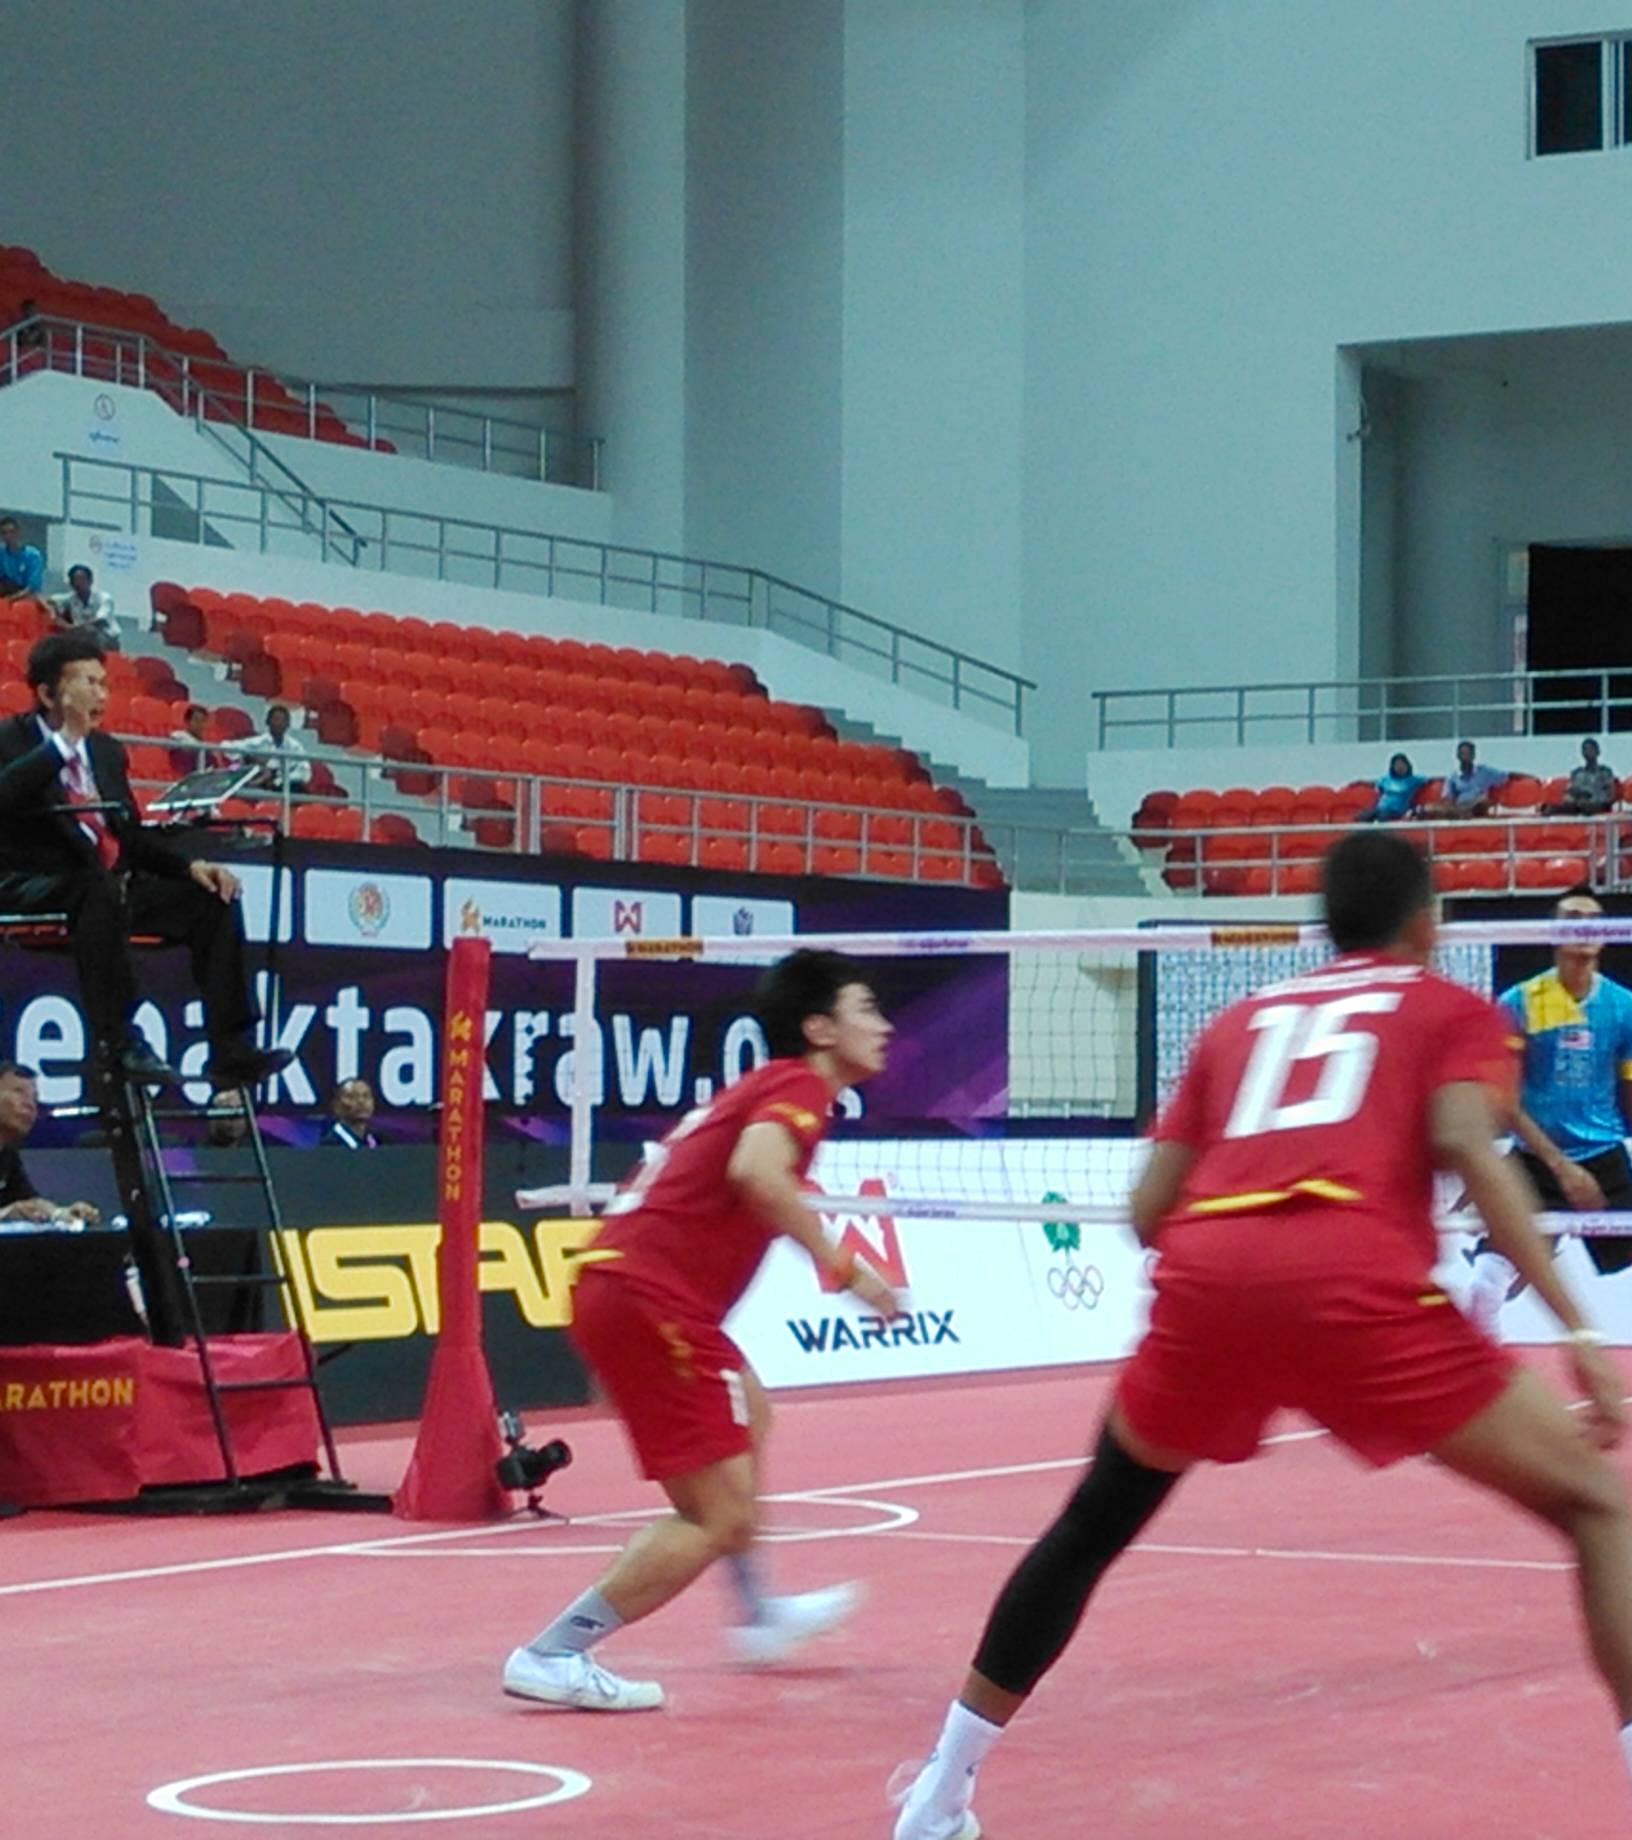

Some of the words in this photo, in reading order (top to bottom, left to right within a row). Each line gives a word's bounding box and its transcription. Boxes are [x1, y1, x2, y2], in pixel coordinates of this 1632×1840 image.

[482, 914, 548, 931] MARATHON
[1222, 991, 1405, 1140] 15
[444, 1049, 469, 1201] MARATHON
[786, 1309, 961, 1354] WARRIX
[0, 1377, 135, 1412] RATHON
